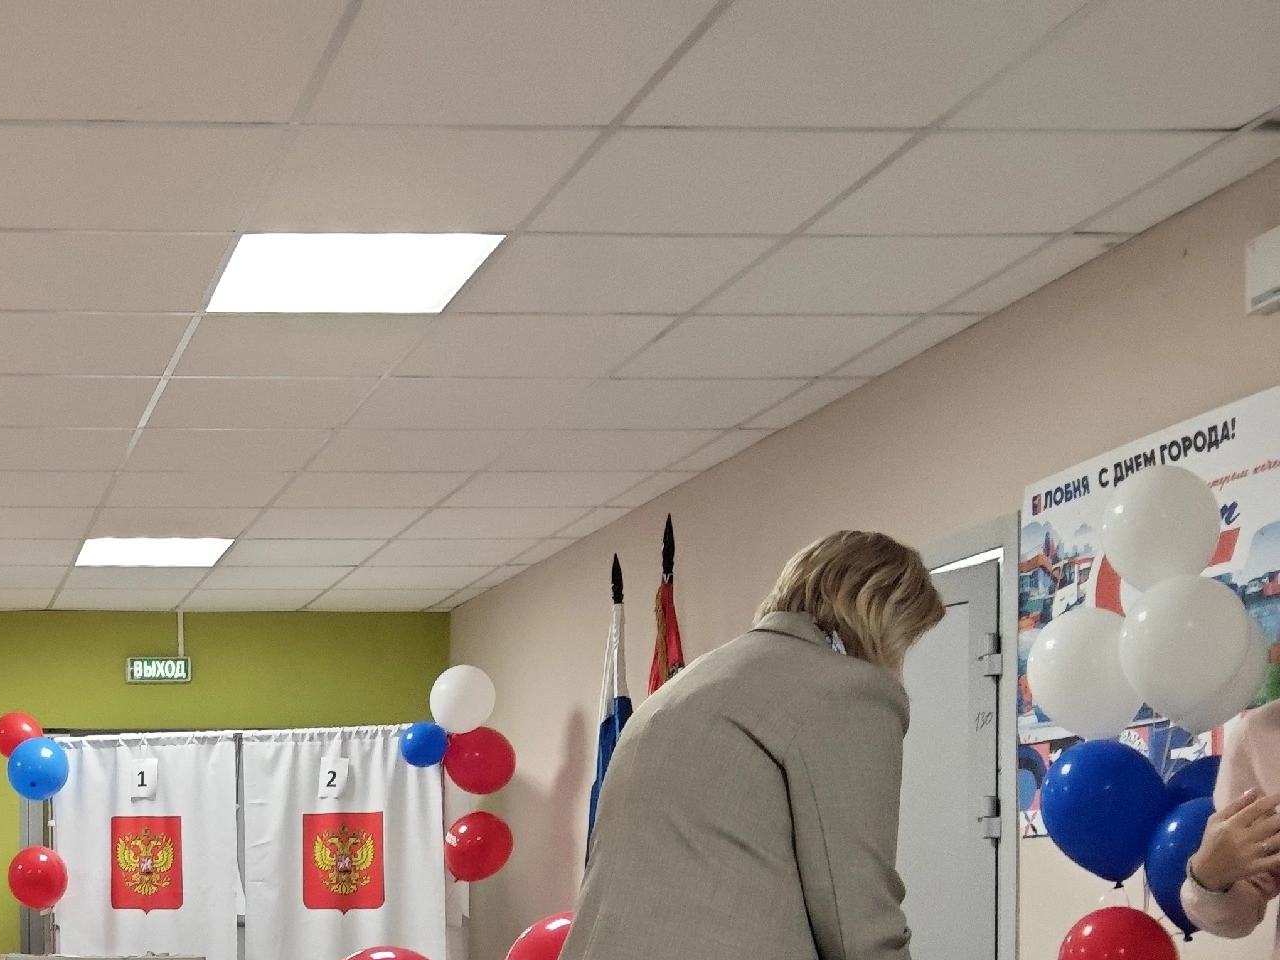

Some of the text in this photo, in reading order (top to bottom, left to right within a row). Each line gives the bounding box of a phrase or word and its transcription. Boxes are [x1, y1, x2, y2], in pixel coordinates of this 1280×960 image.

[1043, 416, 1236, 511] ЛОБНЯ С ДНЕМ ГОРОДА!
[133, 660, 187, 679] ВЫХОД
[137, 770, 148, 787] 1
[326, 770, 337, 788] 2
